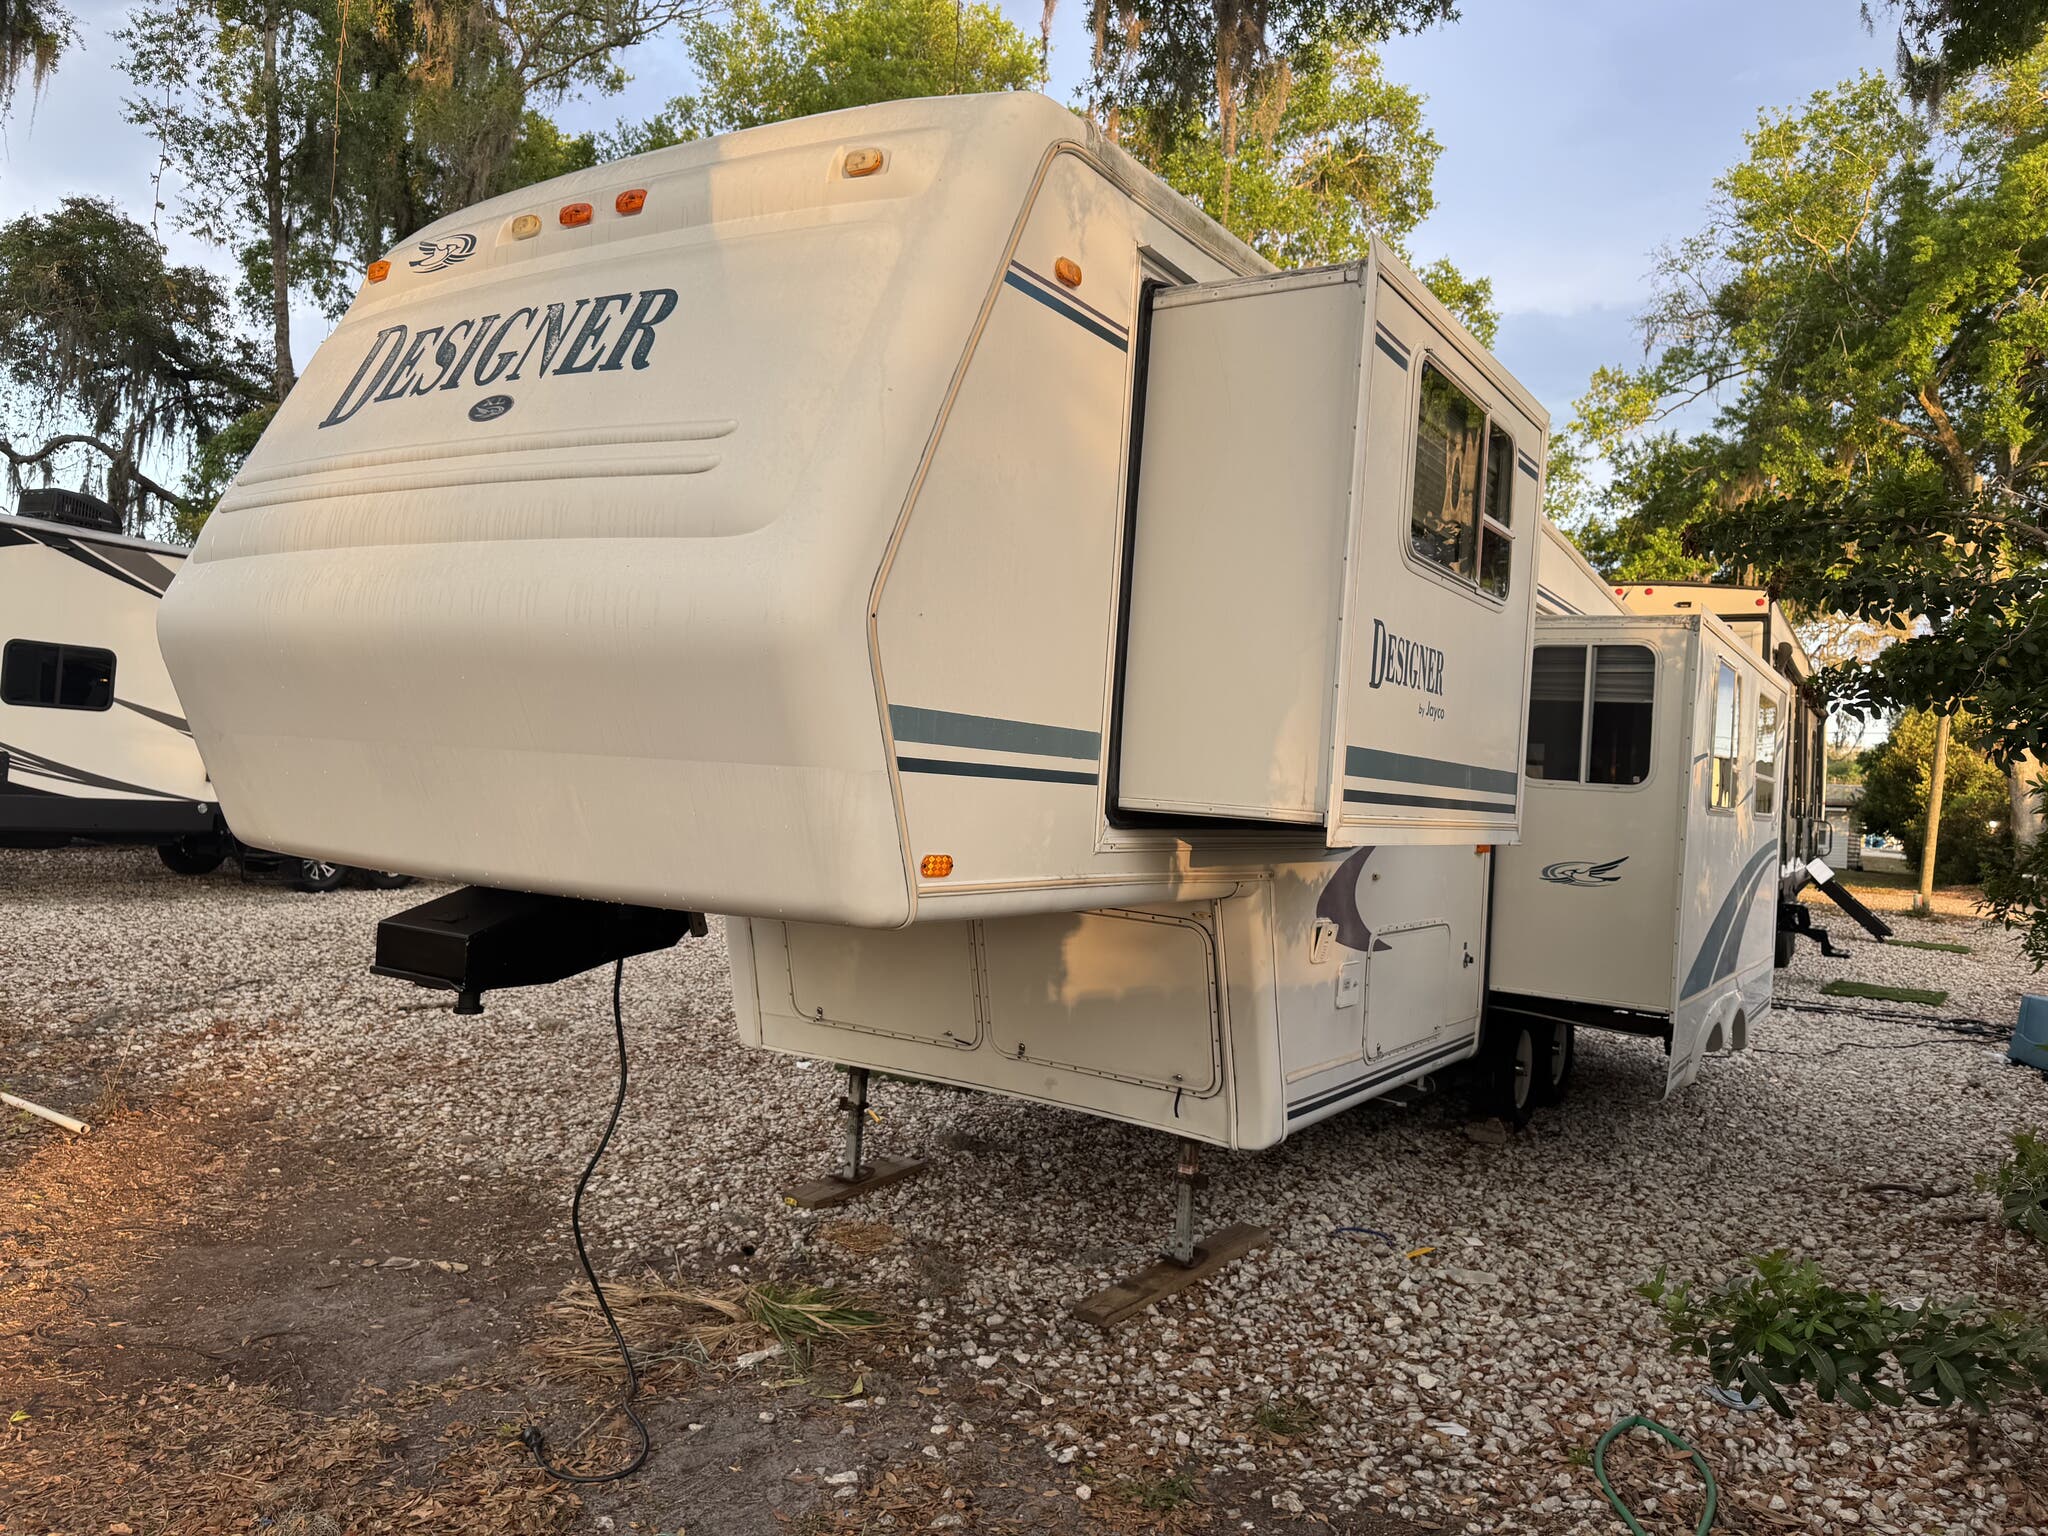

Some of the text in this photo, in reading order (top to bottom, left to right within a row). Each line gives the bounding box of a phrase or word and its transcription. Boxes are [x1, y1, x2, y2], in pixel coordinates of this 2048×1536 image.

[318, 288, 678, 428] DESIGNER
[1369, 618, 1444, 696] DESIGNER
[1418, 700, 1445, 722] by Jayco
